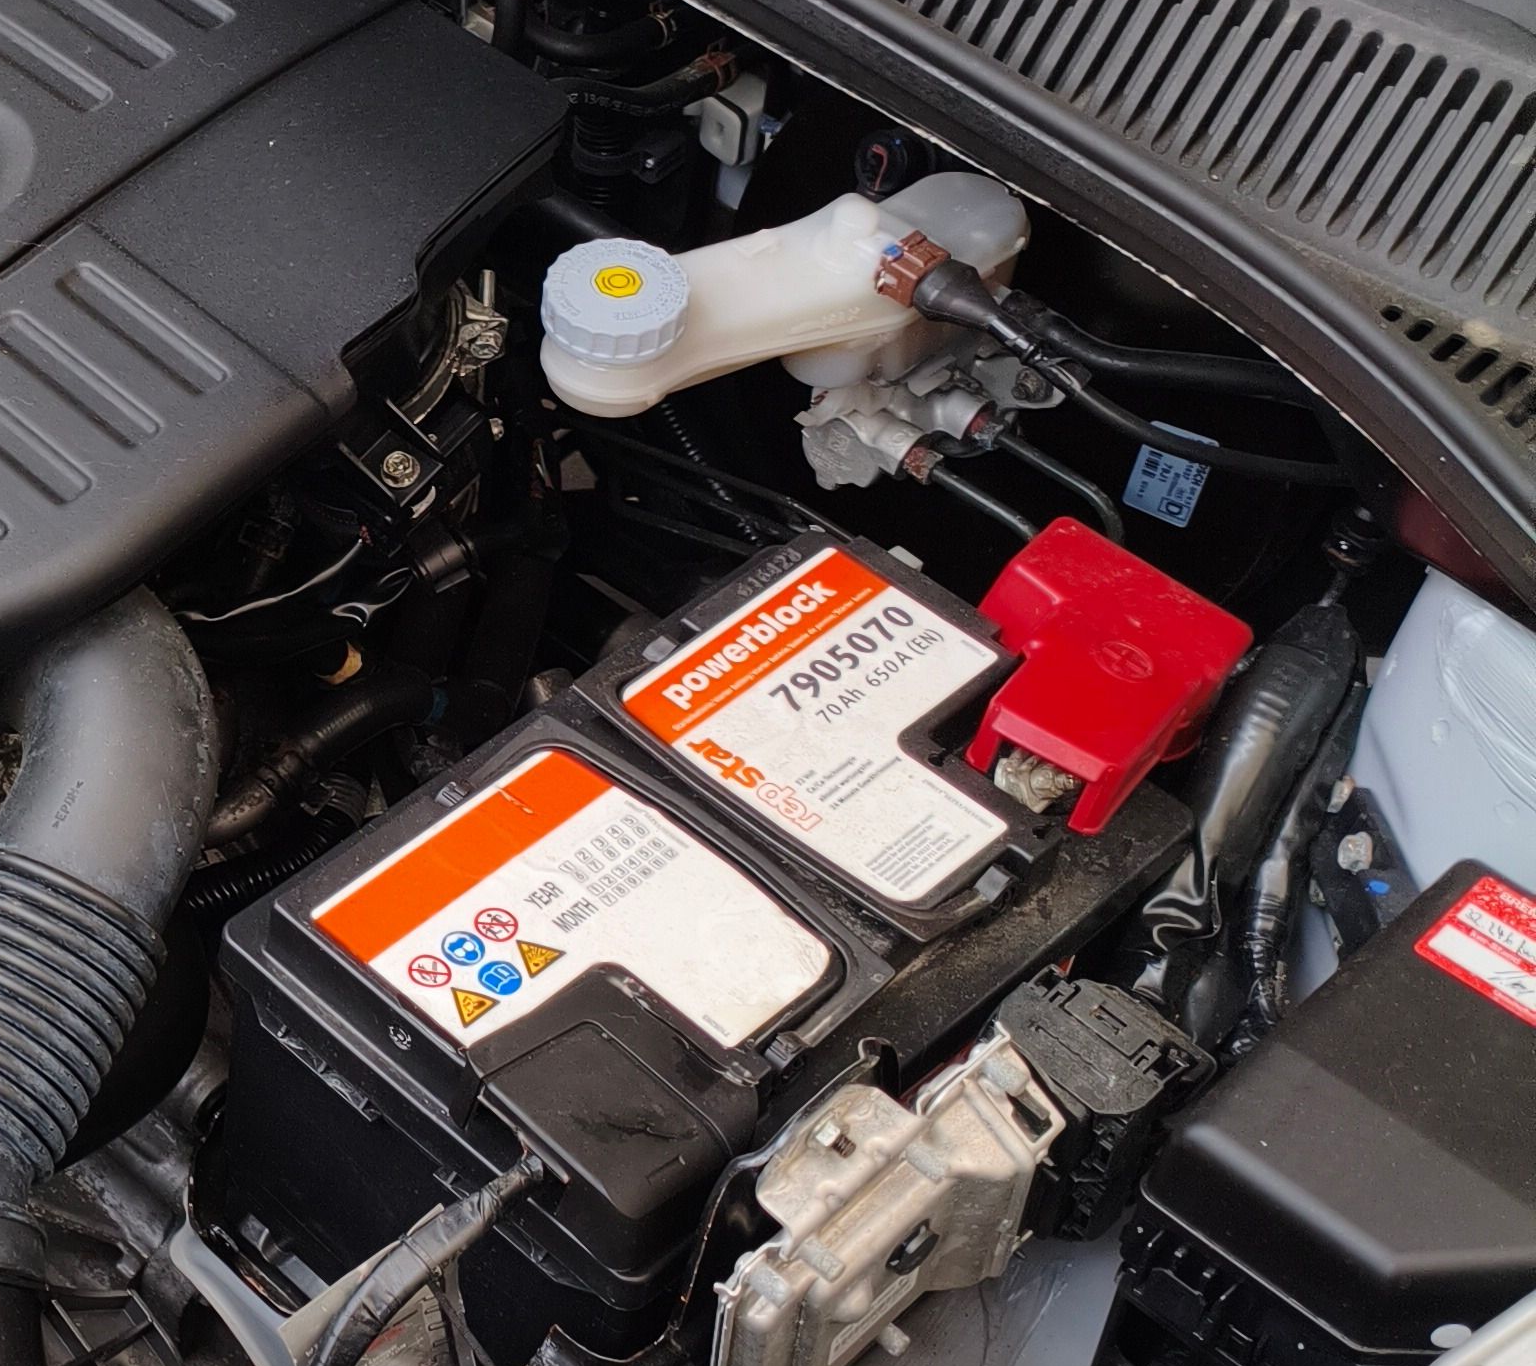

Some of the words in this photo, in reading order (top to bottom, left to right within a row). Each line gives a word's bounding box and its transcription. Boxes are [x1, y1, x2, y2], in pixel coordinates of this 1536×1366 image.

[662, 581, 838, 710] powerblock
[768, 606, 914, 712] 7905070
[907, 628, 945, 655] (EN)
[687, 738, 823, 832] repstar
[524, 881, 564, 910] YEAR
[552, 896, 599, 933] MONTH
